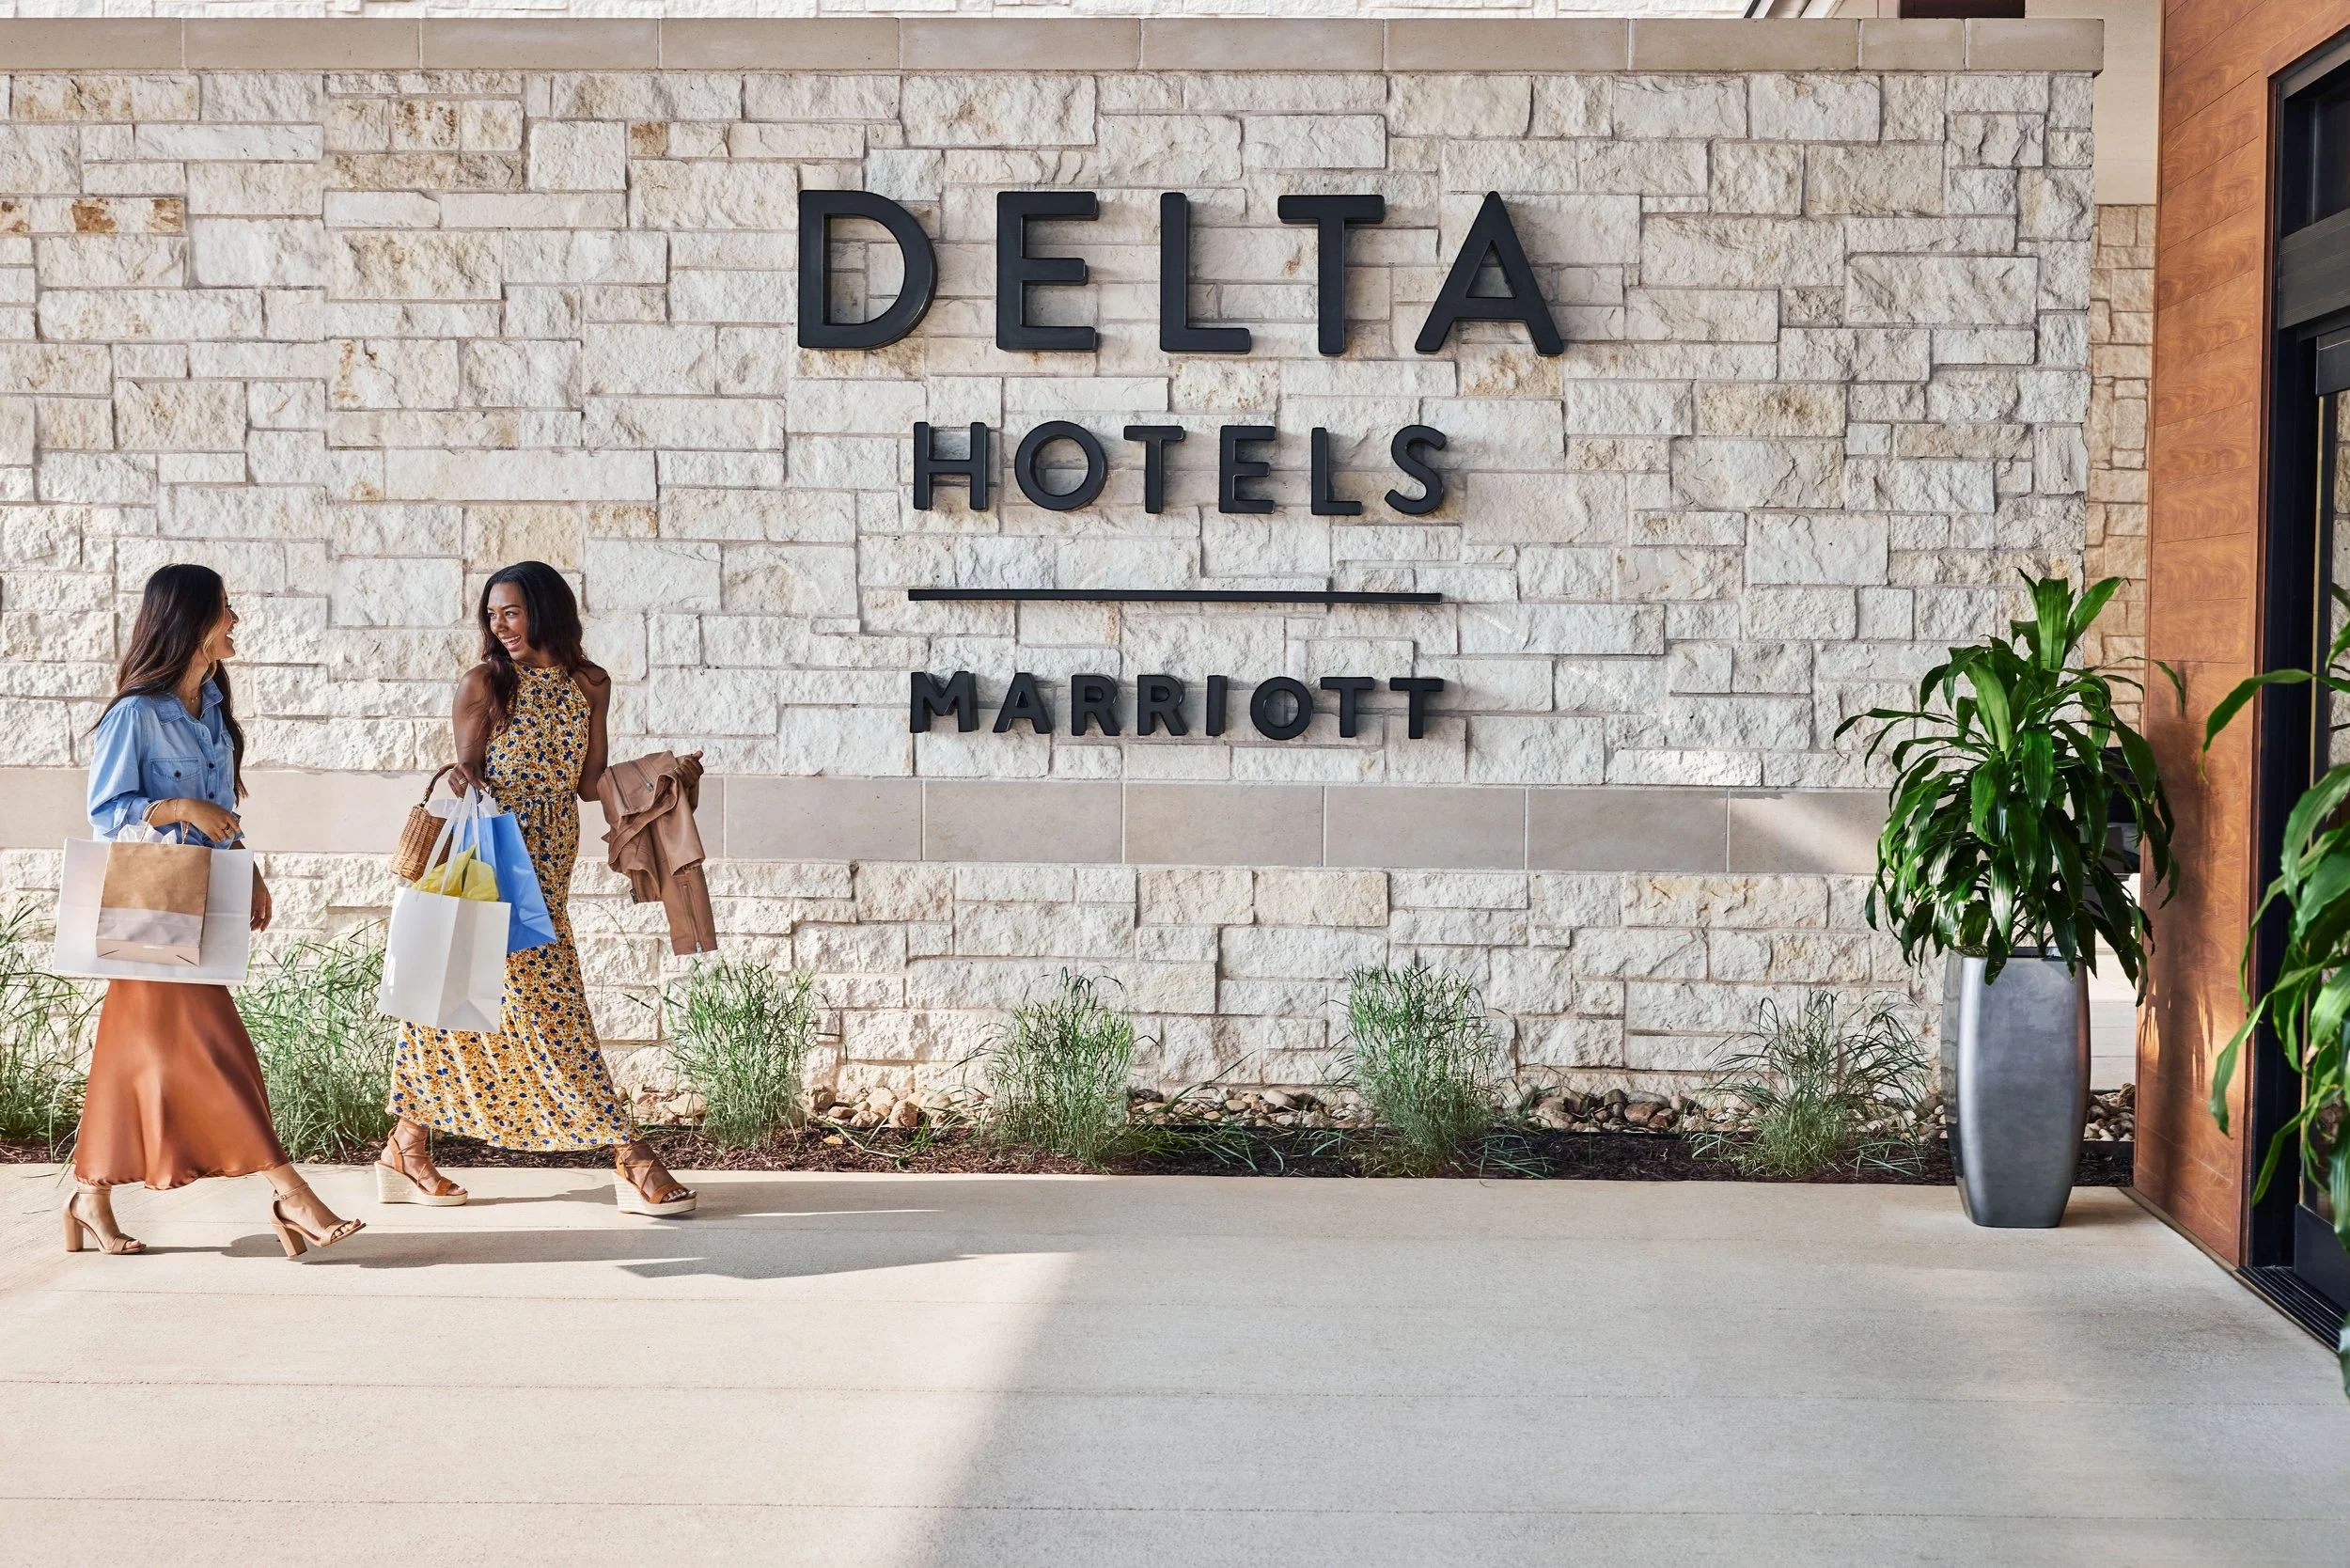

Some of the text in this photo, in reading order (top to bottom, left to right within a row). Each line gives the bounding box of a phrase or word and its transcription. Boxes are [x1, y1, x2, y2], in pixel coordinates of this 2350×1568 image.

[797, 189, 1565, 358] DELTA
[913, 420, 1448, 517] HOTELS
[908, 670, 1445, 741] MARRIOTT
